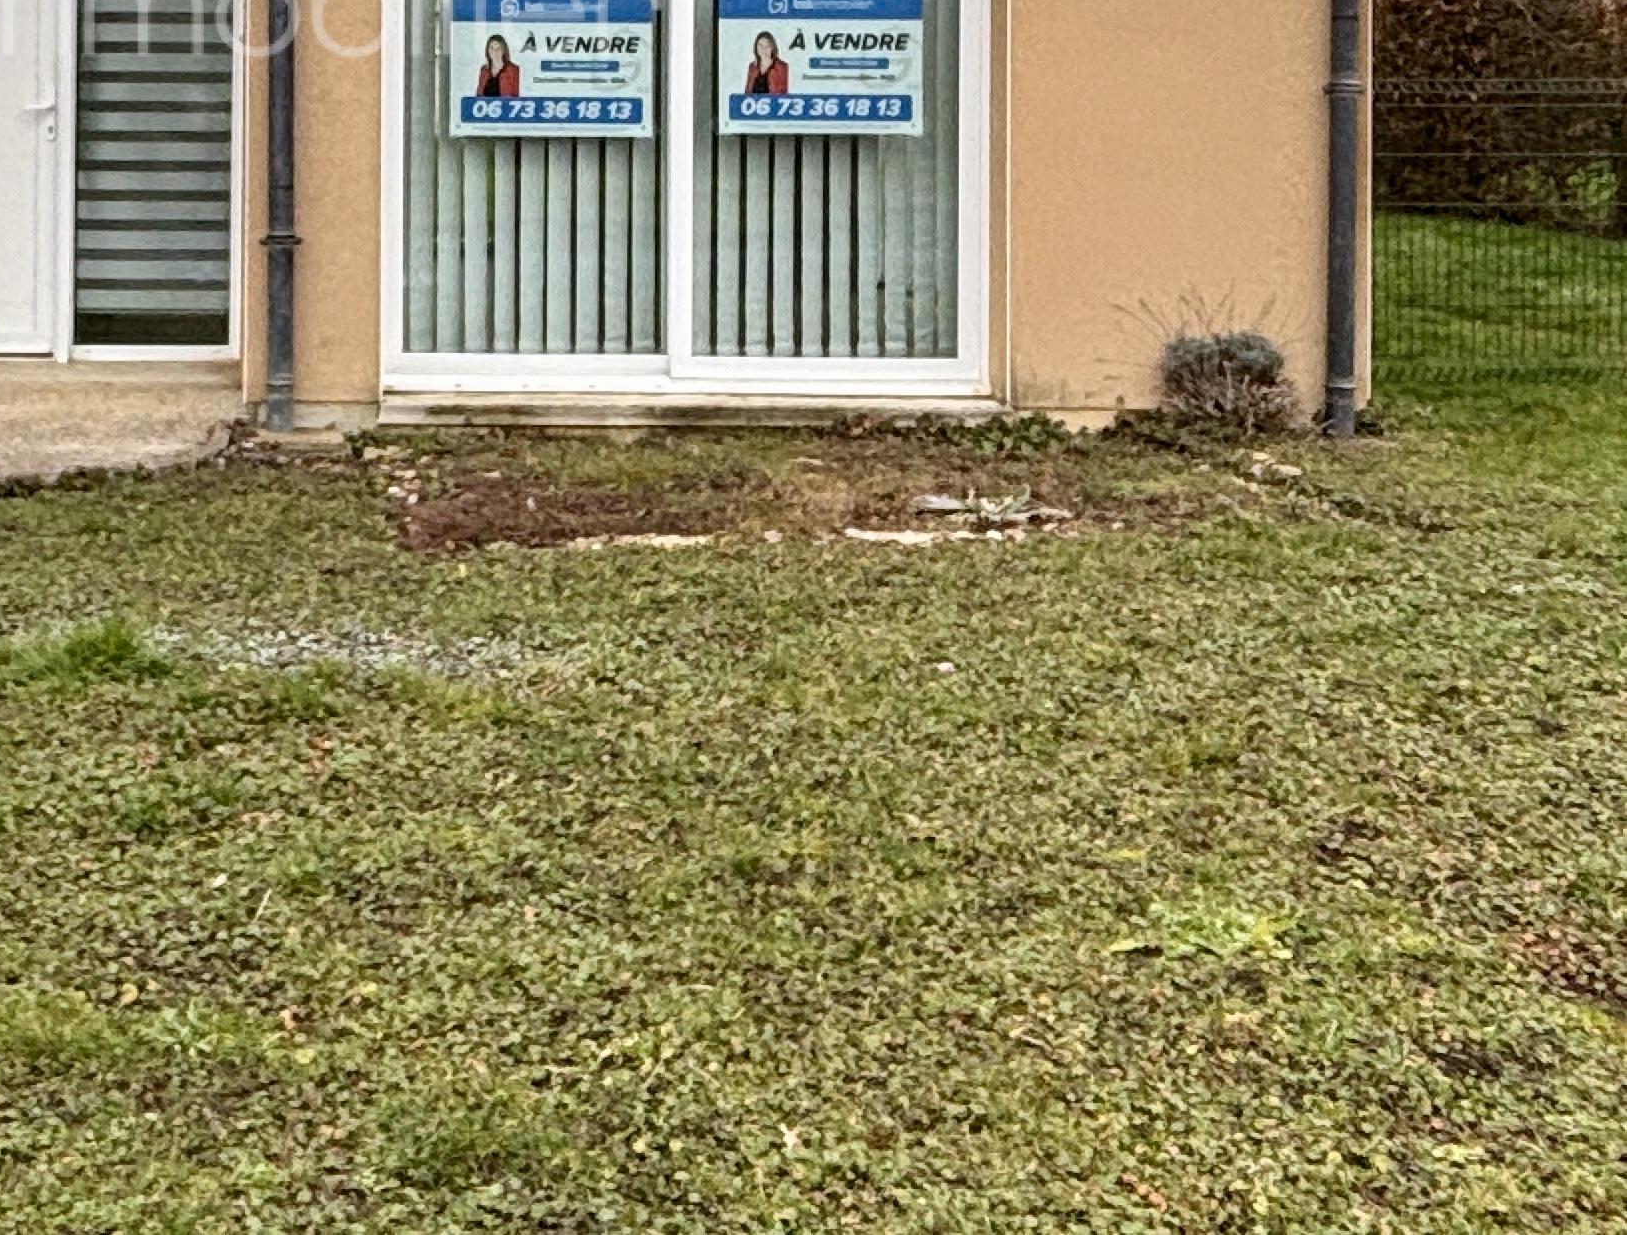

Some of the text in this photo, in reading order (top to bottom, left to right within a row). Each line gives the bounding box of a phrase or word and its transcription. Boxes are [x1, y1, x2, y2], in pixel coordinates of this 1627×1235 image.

[545, 36, 640, 53] VENDRE
[814, 32, 910, 50] VENDRE
[473, 101, 632, 119] 06 73 36 18 13
[740, 98, 902, 116] 06 73 36 18 13
